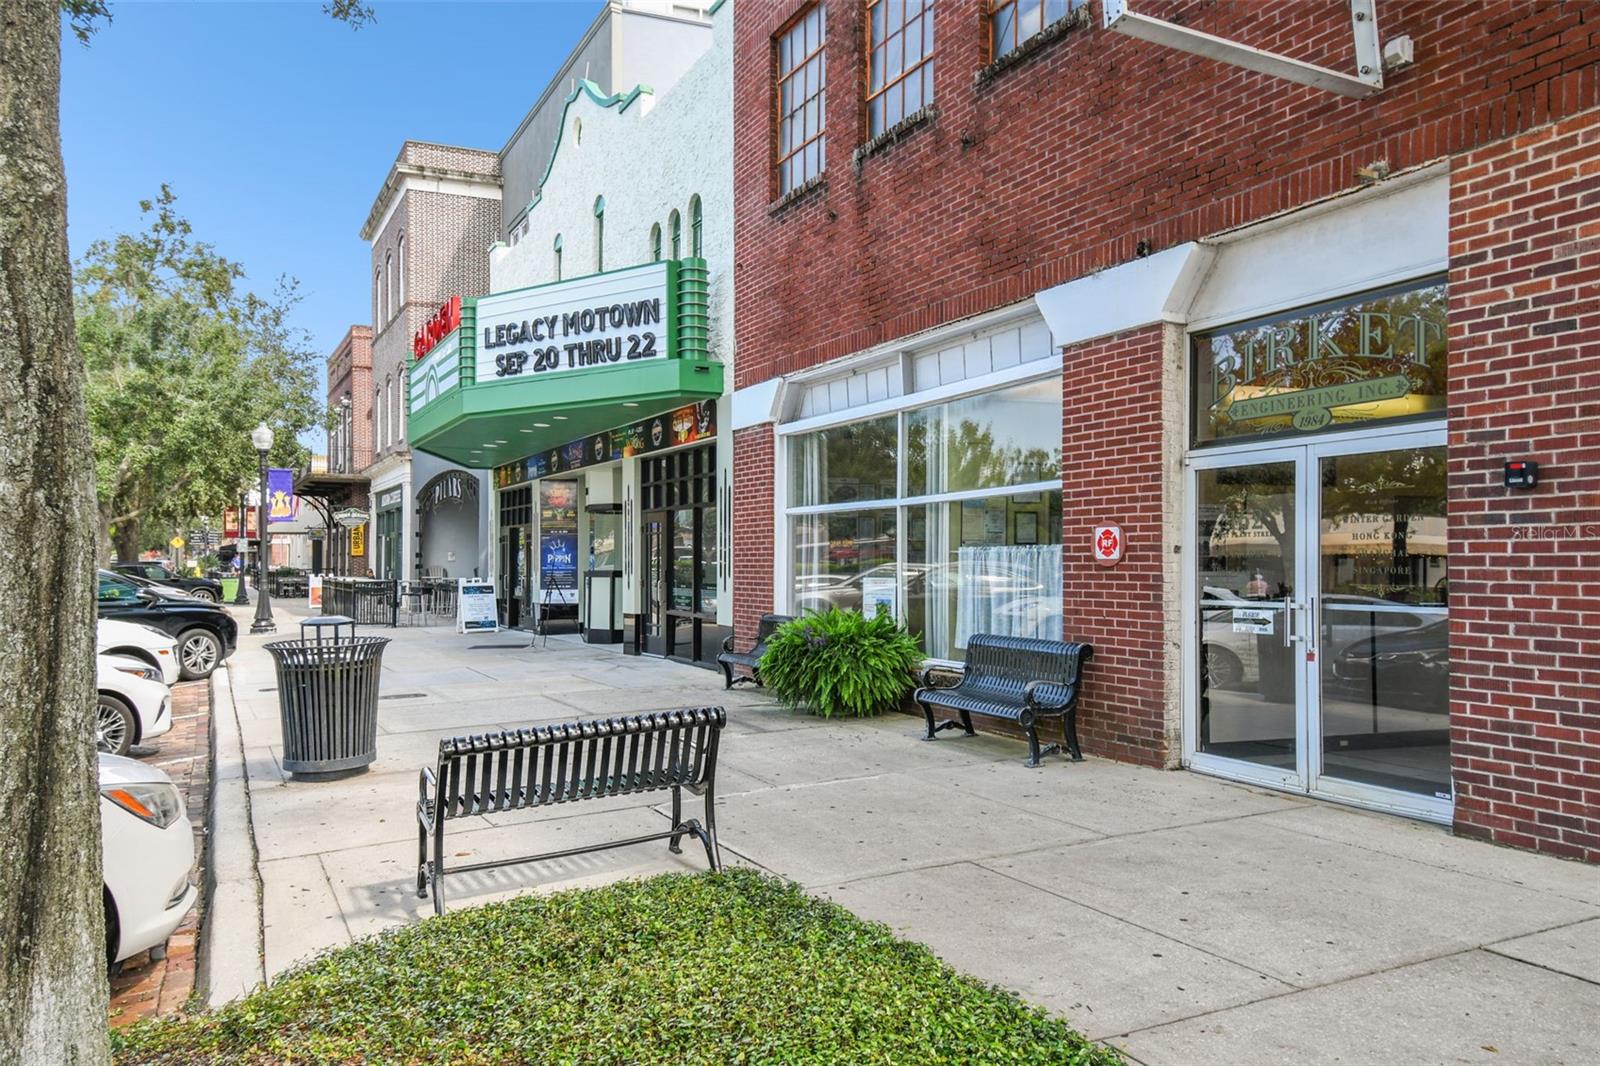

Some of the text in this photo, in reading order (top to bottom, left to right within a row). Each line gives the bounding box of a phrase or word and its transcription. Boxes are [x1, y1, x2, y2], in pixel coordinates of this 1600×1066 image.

[484, 315, 558, 349] LEGACY
[562, 298, 660, 337] MOTOWN
[495, 331, 658, 377] SEP 20 THRU 22
[1208, 312, 1442, 410] BIRKET
[1358, 381, 1394, 399] INC.
[1299, 413, 1326, 428] 1984
[1352, 531, 1413, 541] HONG KONG
